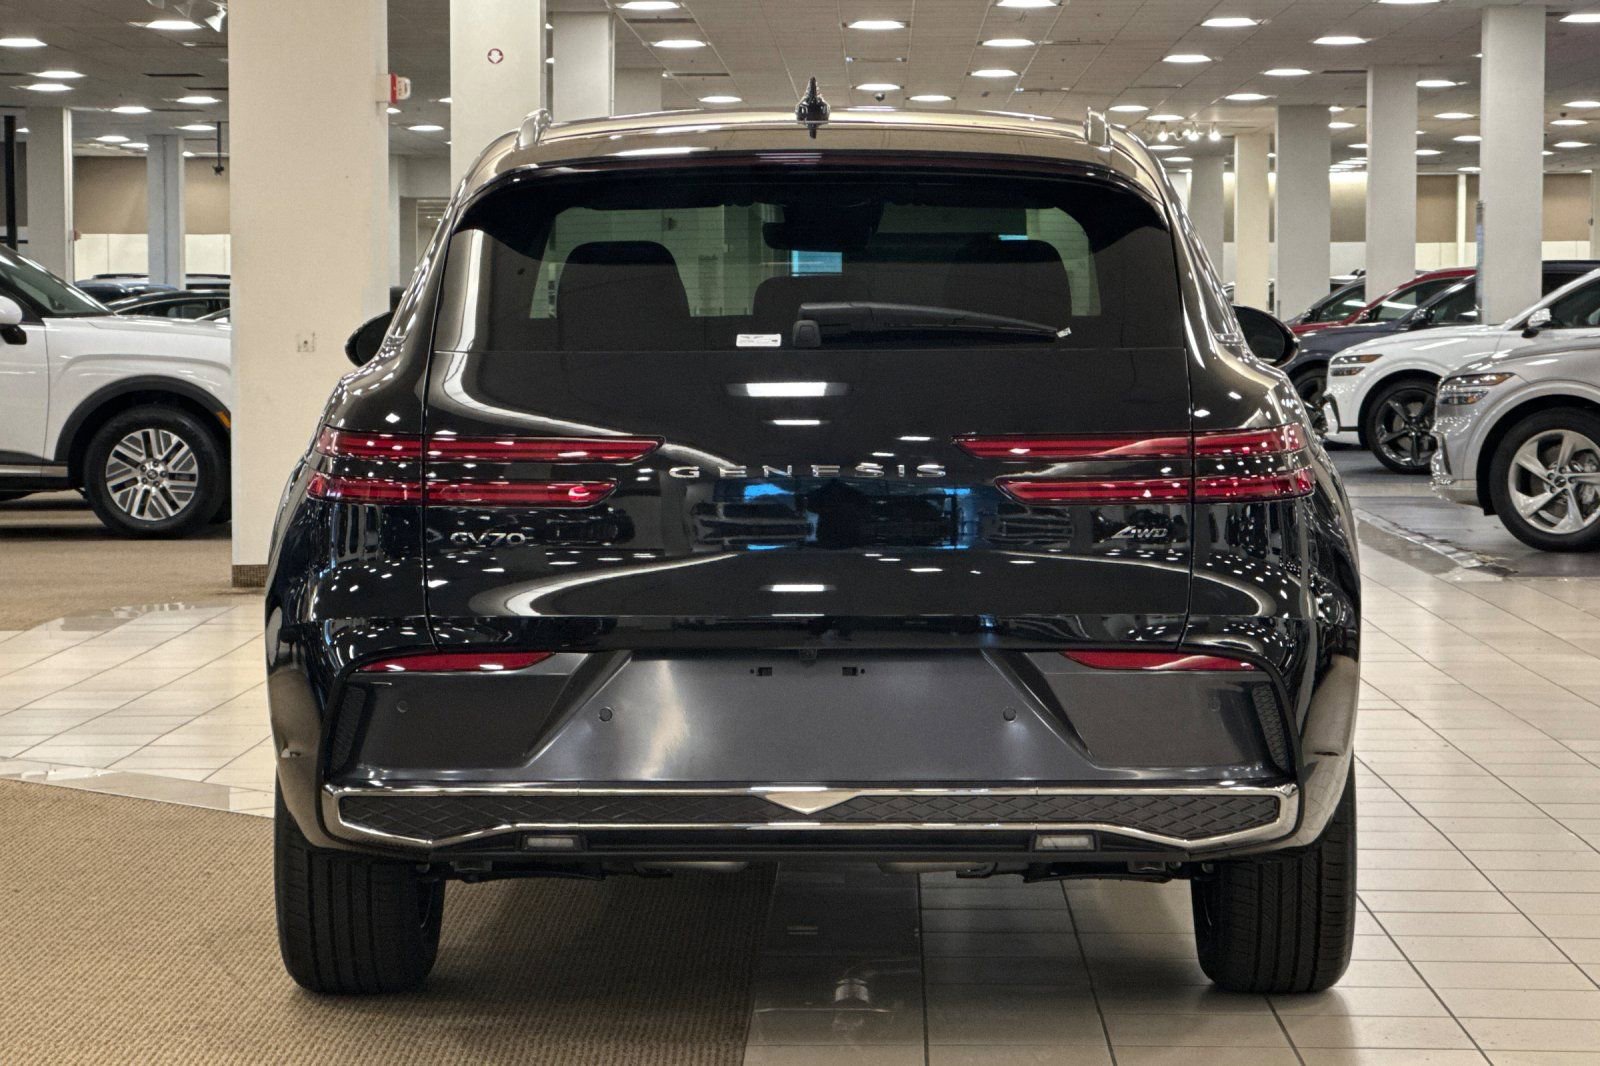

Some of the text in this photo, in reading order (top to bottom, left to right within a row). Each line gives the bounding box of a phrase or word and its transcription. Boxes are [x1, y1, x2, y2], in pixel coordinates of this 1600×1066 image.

[668, 462, 946, 477] GENESIS
[1111, 525, 1168, 538] AWD
[450, 532, 526, 545] GV70
